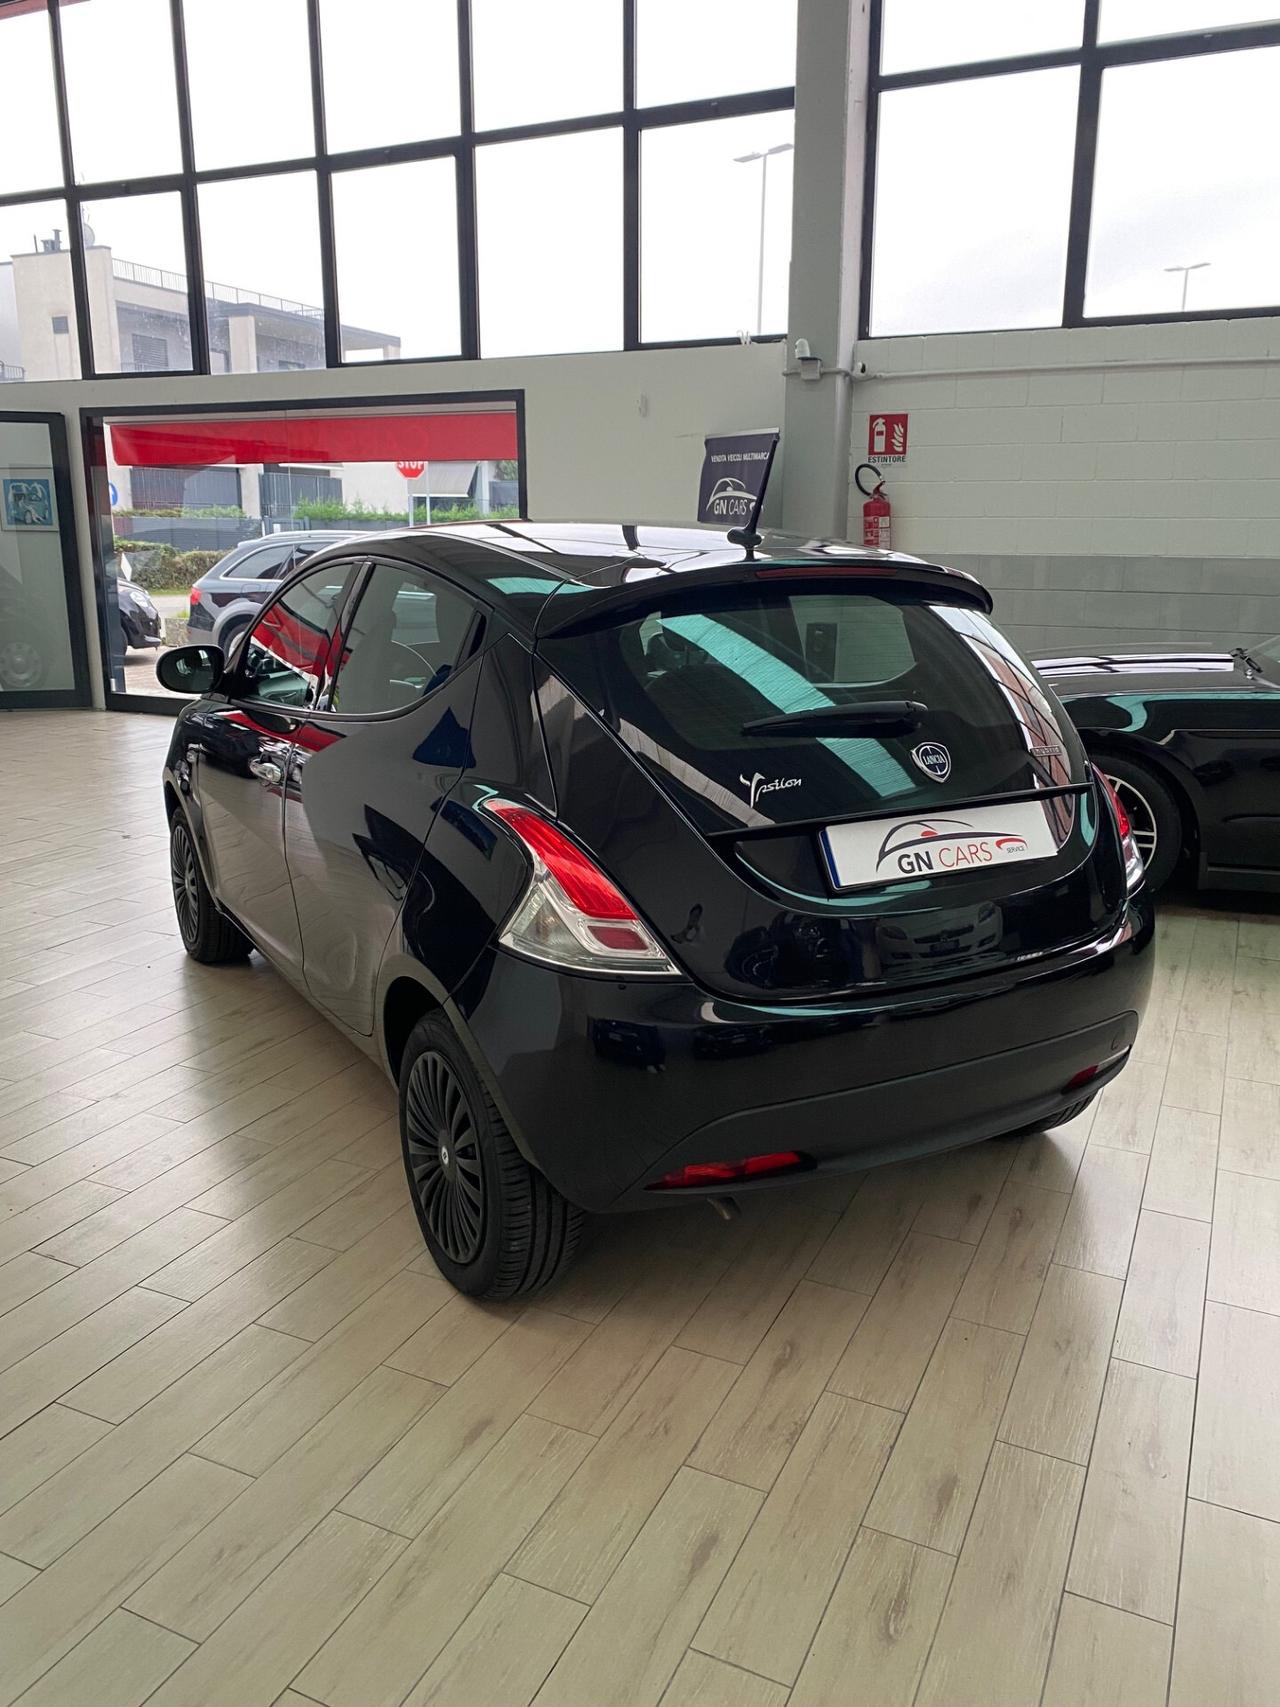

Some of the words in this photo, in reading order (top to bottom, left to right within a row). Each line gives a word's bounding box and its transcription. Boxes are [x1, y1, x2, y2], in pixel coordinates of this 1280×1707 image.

[711, 454, 727, 462] VENDITA
[728, 453, 742, 461] VEICOLI
[398, 461, 424, 469] STOP
[714, 500, 727, 515] GN
[729, 500, 748, 515] CARS
[922, 754, 946, 765] LANCIA
[740, 772, 802, 808] Ypsilon
[1006, 845, 1025, 853] SERVICE
[897, 851, 934, 874] GN
[938, 842, 993, 868] CARS
